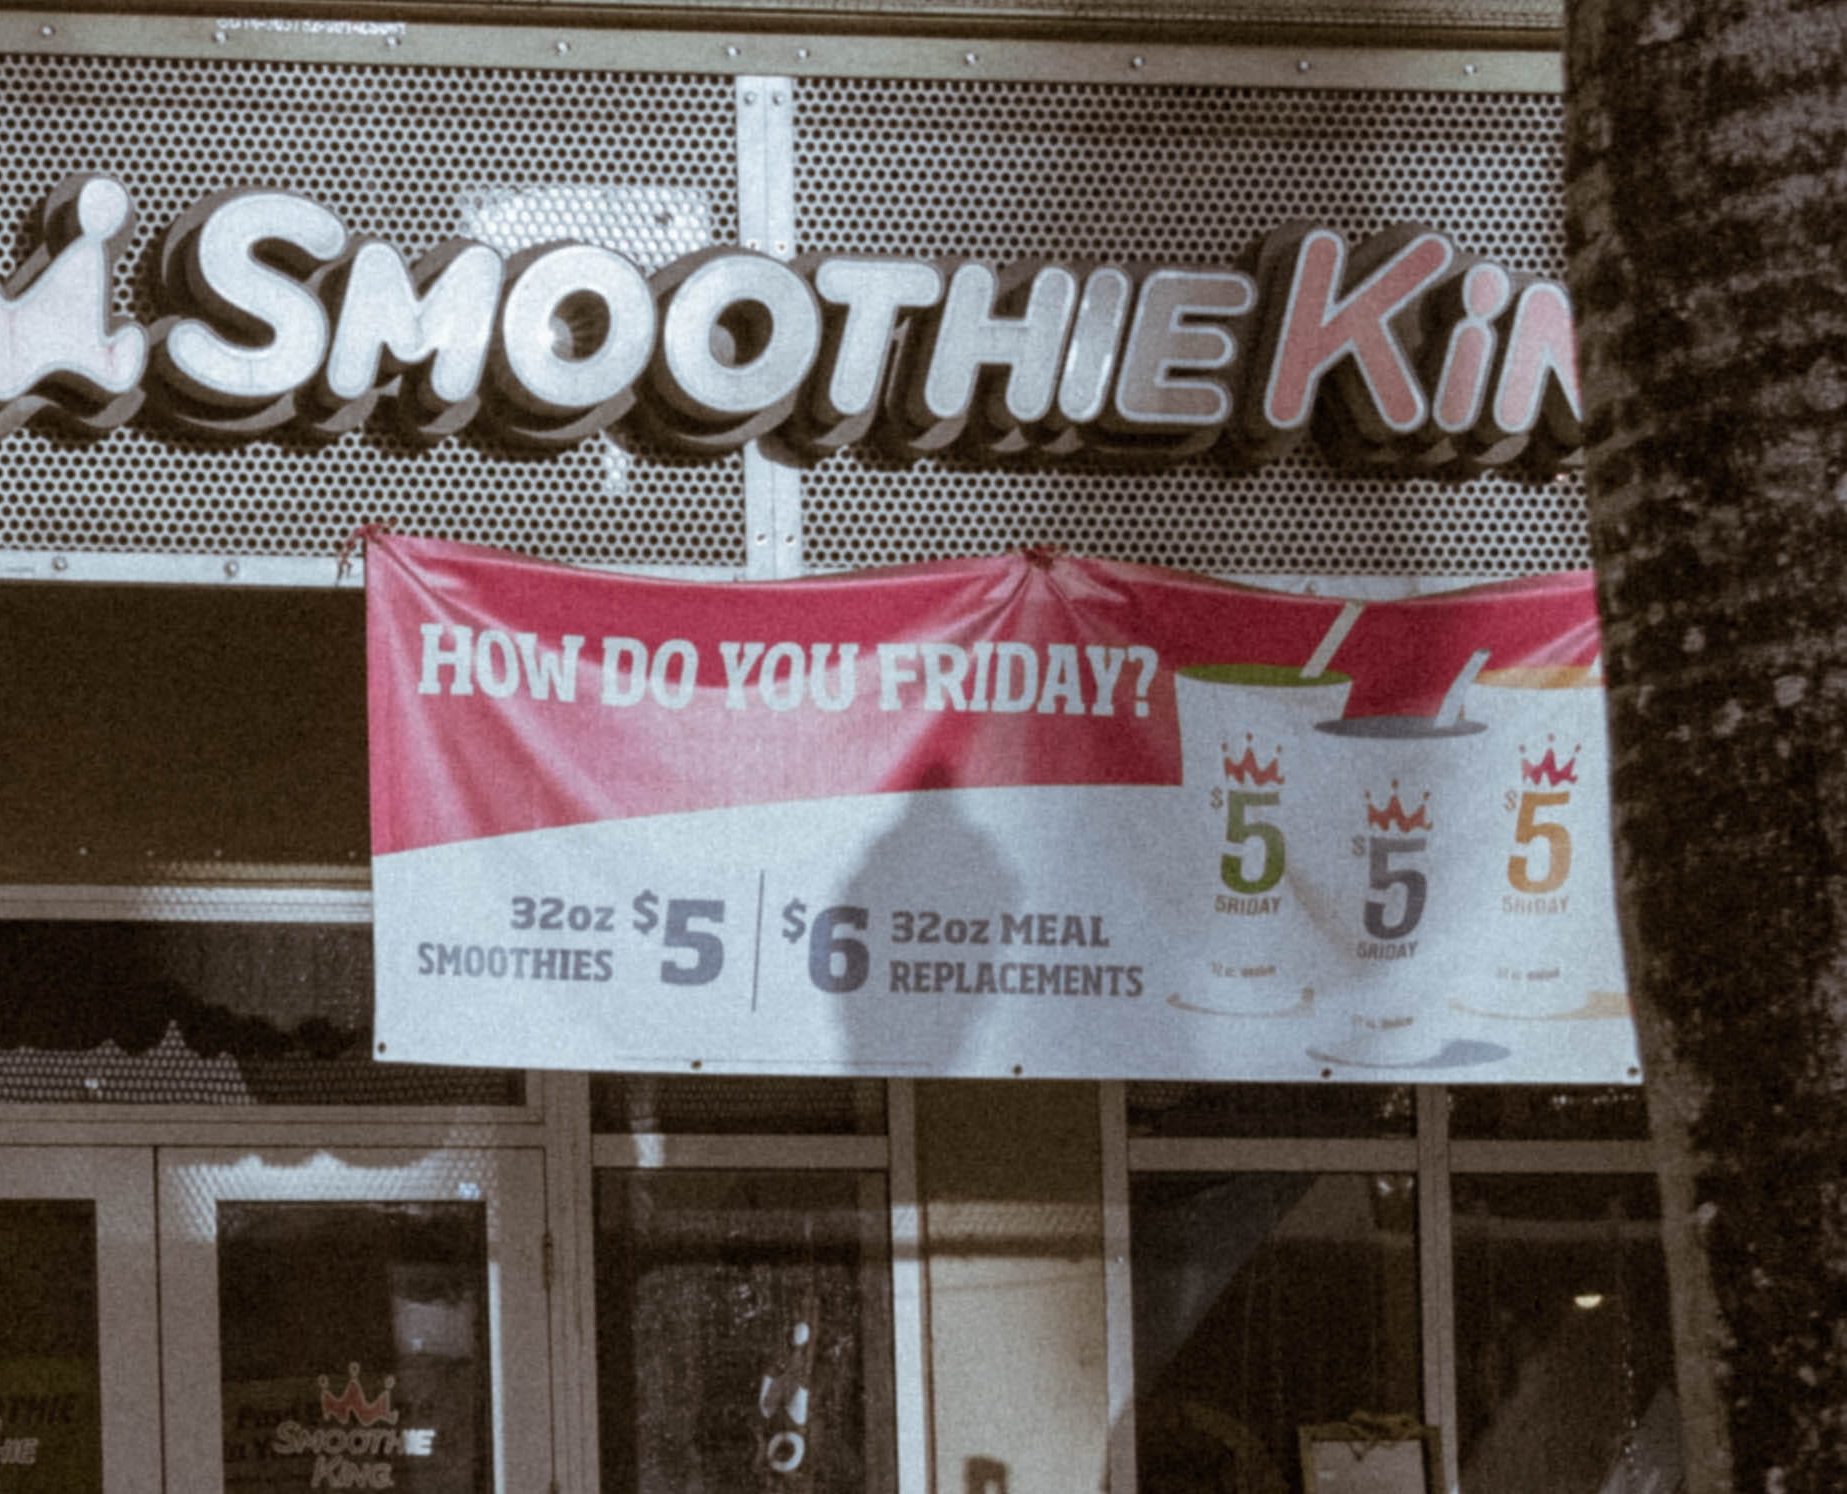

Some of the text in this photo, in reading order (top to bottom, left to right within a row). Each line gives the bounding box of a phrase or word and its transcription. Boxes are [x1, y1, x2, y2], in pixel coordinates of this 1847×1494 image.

[168, 190, 1584, 433] SMOOTHIE KiN
[418, 622, 1159, 718] HOW DO YOU FRIDAY?
[418, 942, 614, 982] SMOOTHIES
[510, 889, 726, 986] 32oz $5
[781, 897, 1110, 994] $6 32oz MEAL
[888, 959, 1144, 998] REPLACEMENTS
[272, 1420, 436, 1456] SMOOTHIE
